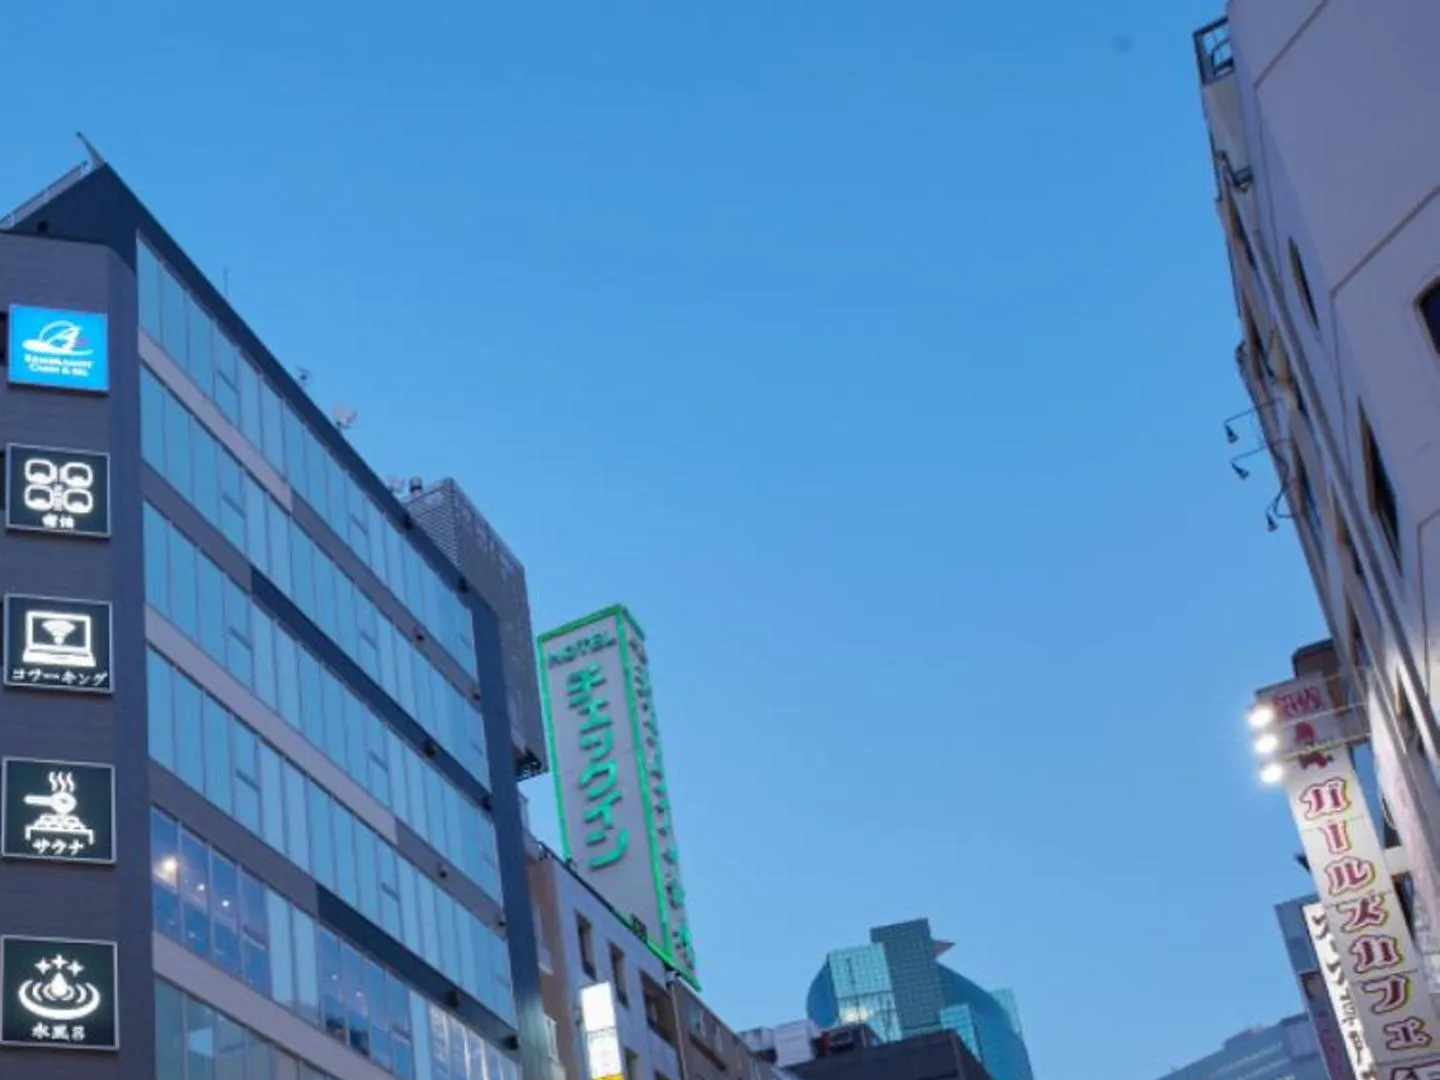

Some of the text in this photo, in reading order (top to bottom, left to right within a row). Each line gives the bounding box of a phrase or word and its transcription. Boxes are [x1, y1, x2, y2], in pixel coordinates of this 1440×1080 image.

[12, 668, 108, 686] コワーキング
[32, 837, 84, 855] サウナ
[1298, 776, 1433, 1051] ガールズカフェ
